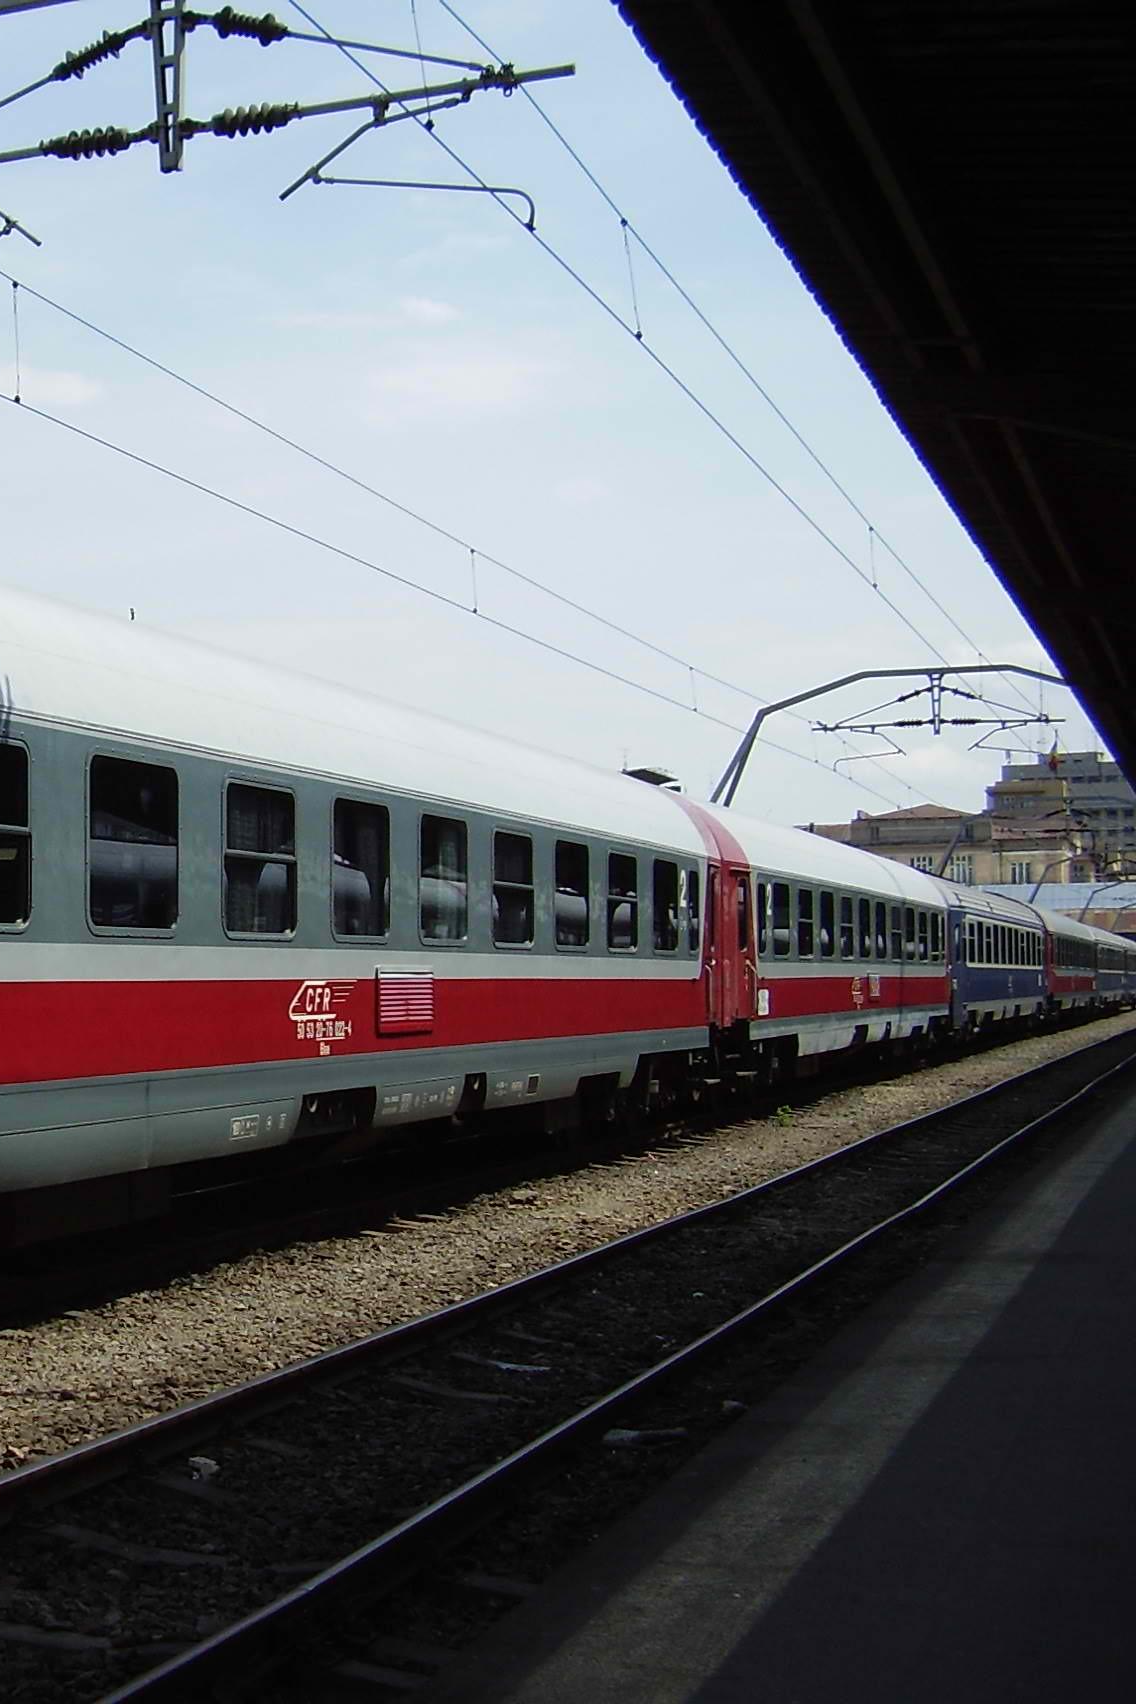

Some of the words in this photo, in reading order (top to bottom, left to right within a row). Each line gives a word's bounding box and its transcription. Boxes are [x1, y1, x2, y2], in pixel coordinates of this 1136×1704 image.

[679, 869, 687, 907] 2
[766, 883, 772, 915] 2
[305, 987, 332, 1012] CFR
